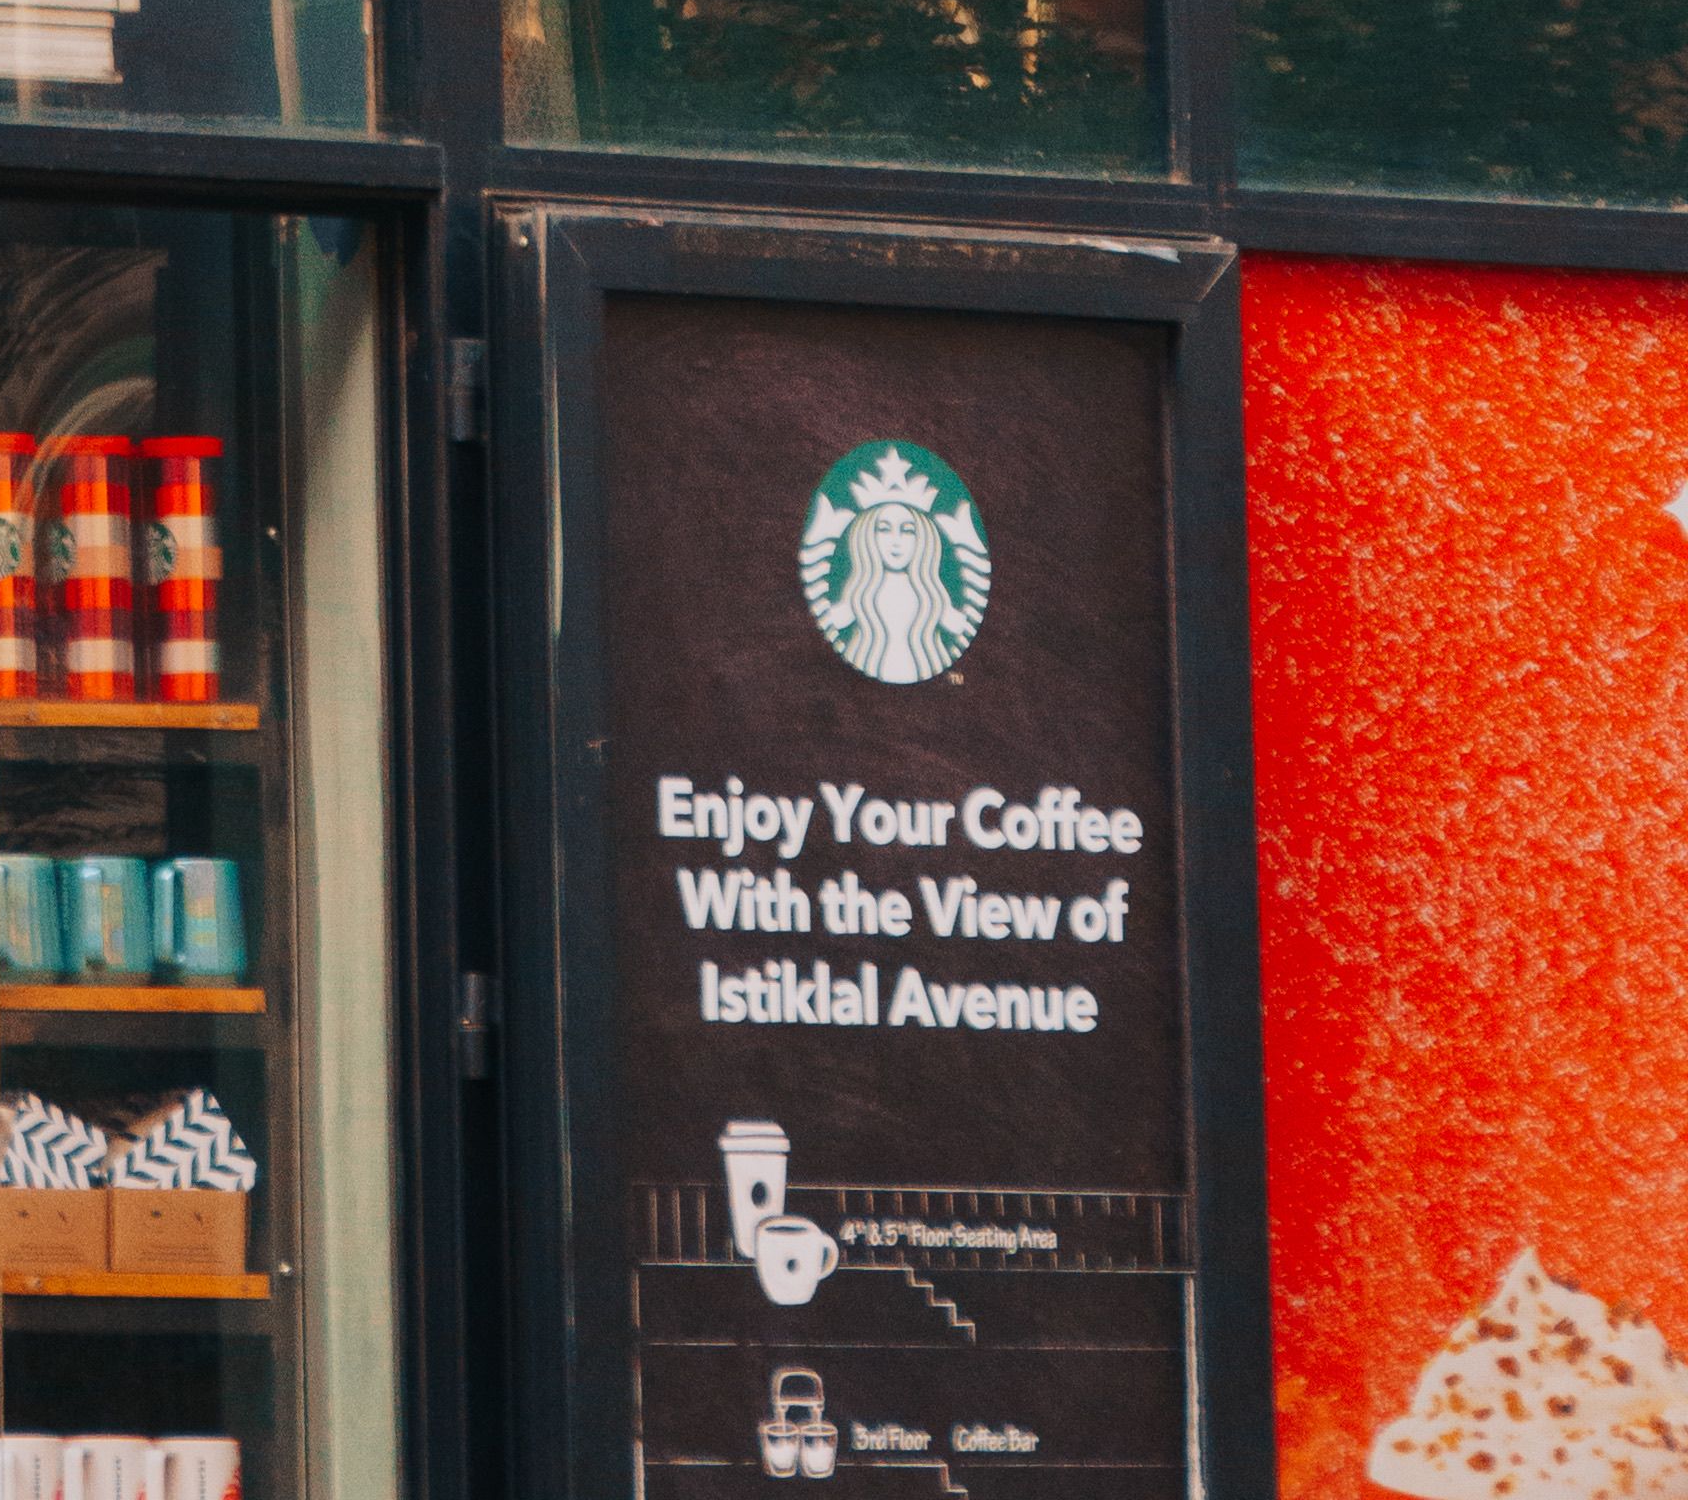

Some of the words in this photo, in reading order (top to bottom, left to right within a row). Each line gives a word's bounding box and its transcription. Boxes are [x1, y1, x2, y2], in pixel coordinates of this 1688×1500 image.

[657, 775, 813, 859] Enjoy
[820, 781, 956, 847] Your
[962, 786, 1144, 853] Coffee
[677, 867, 811, 933] With
[819, 870, 912, 937] the
[918, 875, 1062, 940] View
[1069, 877, 1130, 943] of
[700, 959, 879, 1026] Istiklal
[888, 966, 1099, 1033] Avenue
[867, 1219, 882, 1246] &
[910, 1220, 953, 1248] Floor
[952, 1221, 1017, 1255] Seating
[1018, 1223, 1057, 1249] Area
[888, 1424, 932, 1450] Floor
[953, 1424, 1008, 1451] Coffee
[1008, 1424, 1040, 1451] Bar
